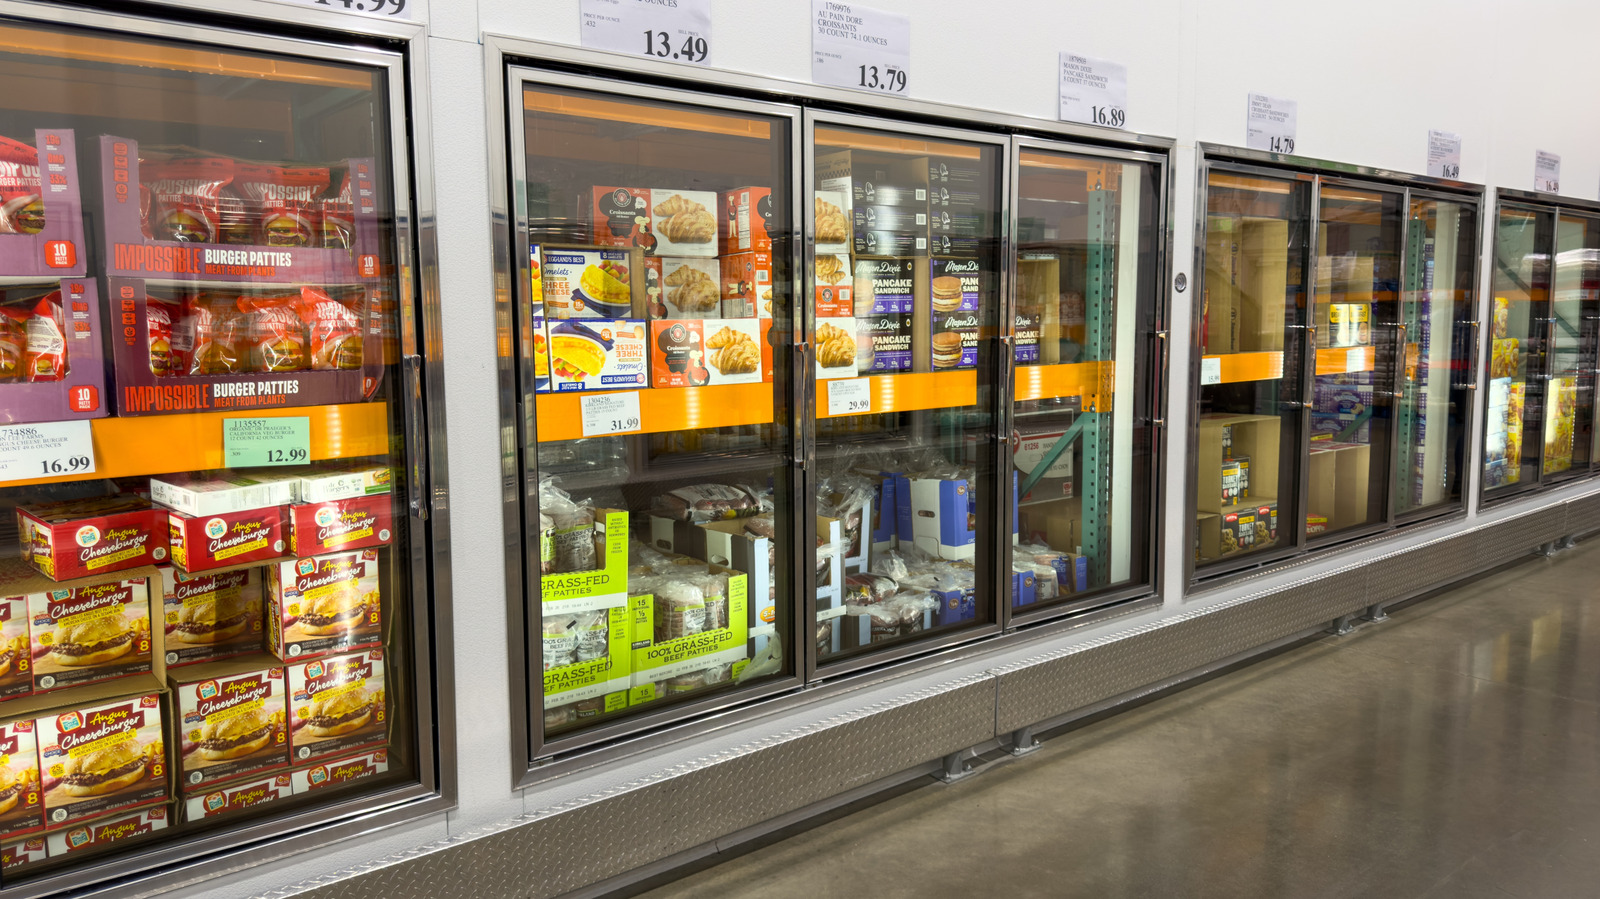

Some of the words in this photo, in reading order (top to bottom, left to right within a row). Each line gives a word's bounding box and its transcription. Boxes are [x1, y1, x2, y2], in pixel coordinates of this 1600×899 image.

[315, 0, 406, 15] .99
[818, 18, 857, 32] CROISSANTS
[829, 13, 845, 22] PAIN
[846, 16, 863, 25] DORE
[826, 28, 848, 39] COUNT
[850, 32, 862, 41] 74.1
[862, 35, 888, 46] OUNCES
[643, 30, 708, 62] 13.49
[1064, 62, 1080, 70] MASON
[858, 64, 907, 92] 13.79
[1064, 69, 1084, 79] PANCAKE
[1084, 73, 1108, 83] SANDWICH
[1088, 81, 1106, 89] OUNCES
[1092, 105, 1125, 127] 16.89
[1270, 136, 1295, 154] 14.79
[1442, 164, 1460, 178] 16.49
[0, 177, 16, 187] RGER
[18, 178, 42, 187] PATTIES
[50, 174, 68, 184] 33%
[54, 244, 67, 256] 10
[114, 243, 201, 274] IMPOSSIBLE
[205, 248, 248, 266] BURGER
[250, 252, 292, 267] PATTIES
[364, 256, 374, 267] 10
[206, 264, 225, 275] MEAT
[226, 266, 246, 276] FROM
[248, 266, 276, 276] PLANTS
[855, 262, 880, 274] Mason
[880, 261, 902, 274] Dixie
[872, 278, 912, 288] PANCAKE
[74, 322, 91, 332] 33%
[856, 320, 880, 332] Mason
[880, 318, 901, 331] Dixie
[1016, 316, 1032, 326] Dixie
[872, 336, 911, 344] PANCAKE
[616, 362, 644, 372] Omelets
[78, 388, 90, 400] 10
[125, 384, 210, 412] IMPOSSIBLE
[214, 380, 255, 398] BURGER
[258, 380, 299, 395] PATTIES
[214, 397, 234, 408] MEAT
[236, 397, 257, 406] FROM
[259, 394, 286, 404] PLANTS
[849, 400, 869, 410] 29.99
[611, 418, 638, 430] 31.99
[2, 428, 38, 438] 734886
[267, 448, 306, 462] 12.99
[41, 456, 90, 474] 16.99
[340, 510, 368, 522] Angus
[105, 528, 138, 541] Angus
[232, 522, 262, 534] Angus
[318, 516, 376, 540] Cheeseburger
[209, 526, 271, 552] Cheeseburger
[80, 534, 149, 562] Cheeseburger
[322, 560, 353, 572] Angus
[298, 565, 362, 592] Cheeseburger
[541, 574, 610, 591] GRASS-FED
[79, 584, 118, 598] Angus
[177, 574, 246, 600] Cheeseburger
[554, 587, 592, 597] PATTIES
[50, 590, 128, 620] Cheeseburger
[370, 612, 378, 624] 8
[253, 620, 262, 632] 8
[140, 640, 149, 652] 8
[647, 647, 672, 660] 100%
[673, 632, 733, 653] GRASS-FED
[664, 654, 684, 662] BEEF
[687, 644, 719, 657] PATTIES
[18, 659, 28, 672] 8
[329, 660, 360, 674] Angus
[307, 666, 369, 694] Cheeseburger
[543, 660, 613, 686] GRASS-FED
[224, 680, 258, 694] Angus
[558, 675, 596, 690] PATTIES
[200, 686, 268, 716] Cheeseburger
[90, 710, 129, 726] Angus
[377, 710, 384, 722] 8
[61, 714, 141, 750] Cheeseburger
[277, 732, 286, 743] 8
[153, 764, 164, 776] 8
[333, 764, 365, 779] Angus
[28, 792, 38, 804] 8
[231, 788, 266, 804] Angus
[98, 823, 137, 840] Angus
